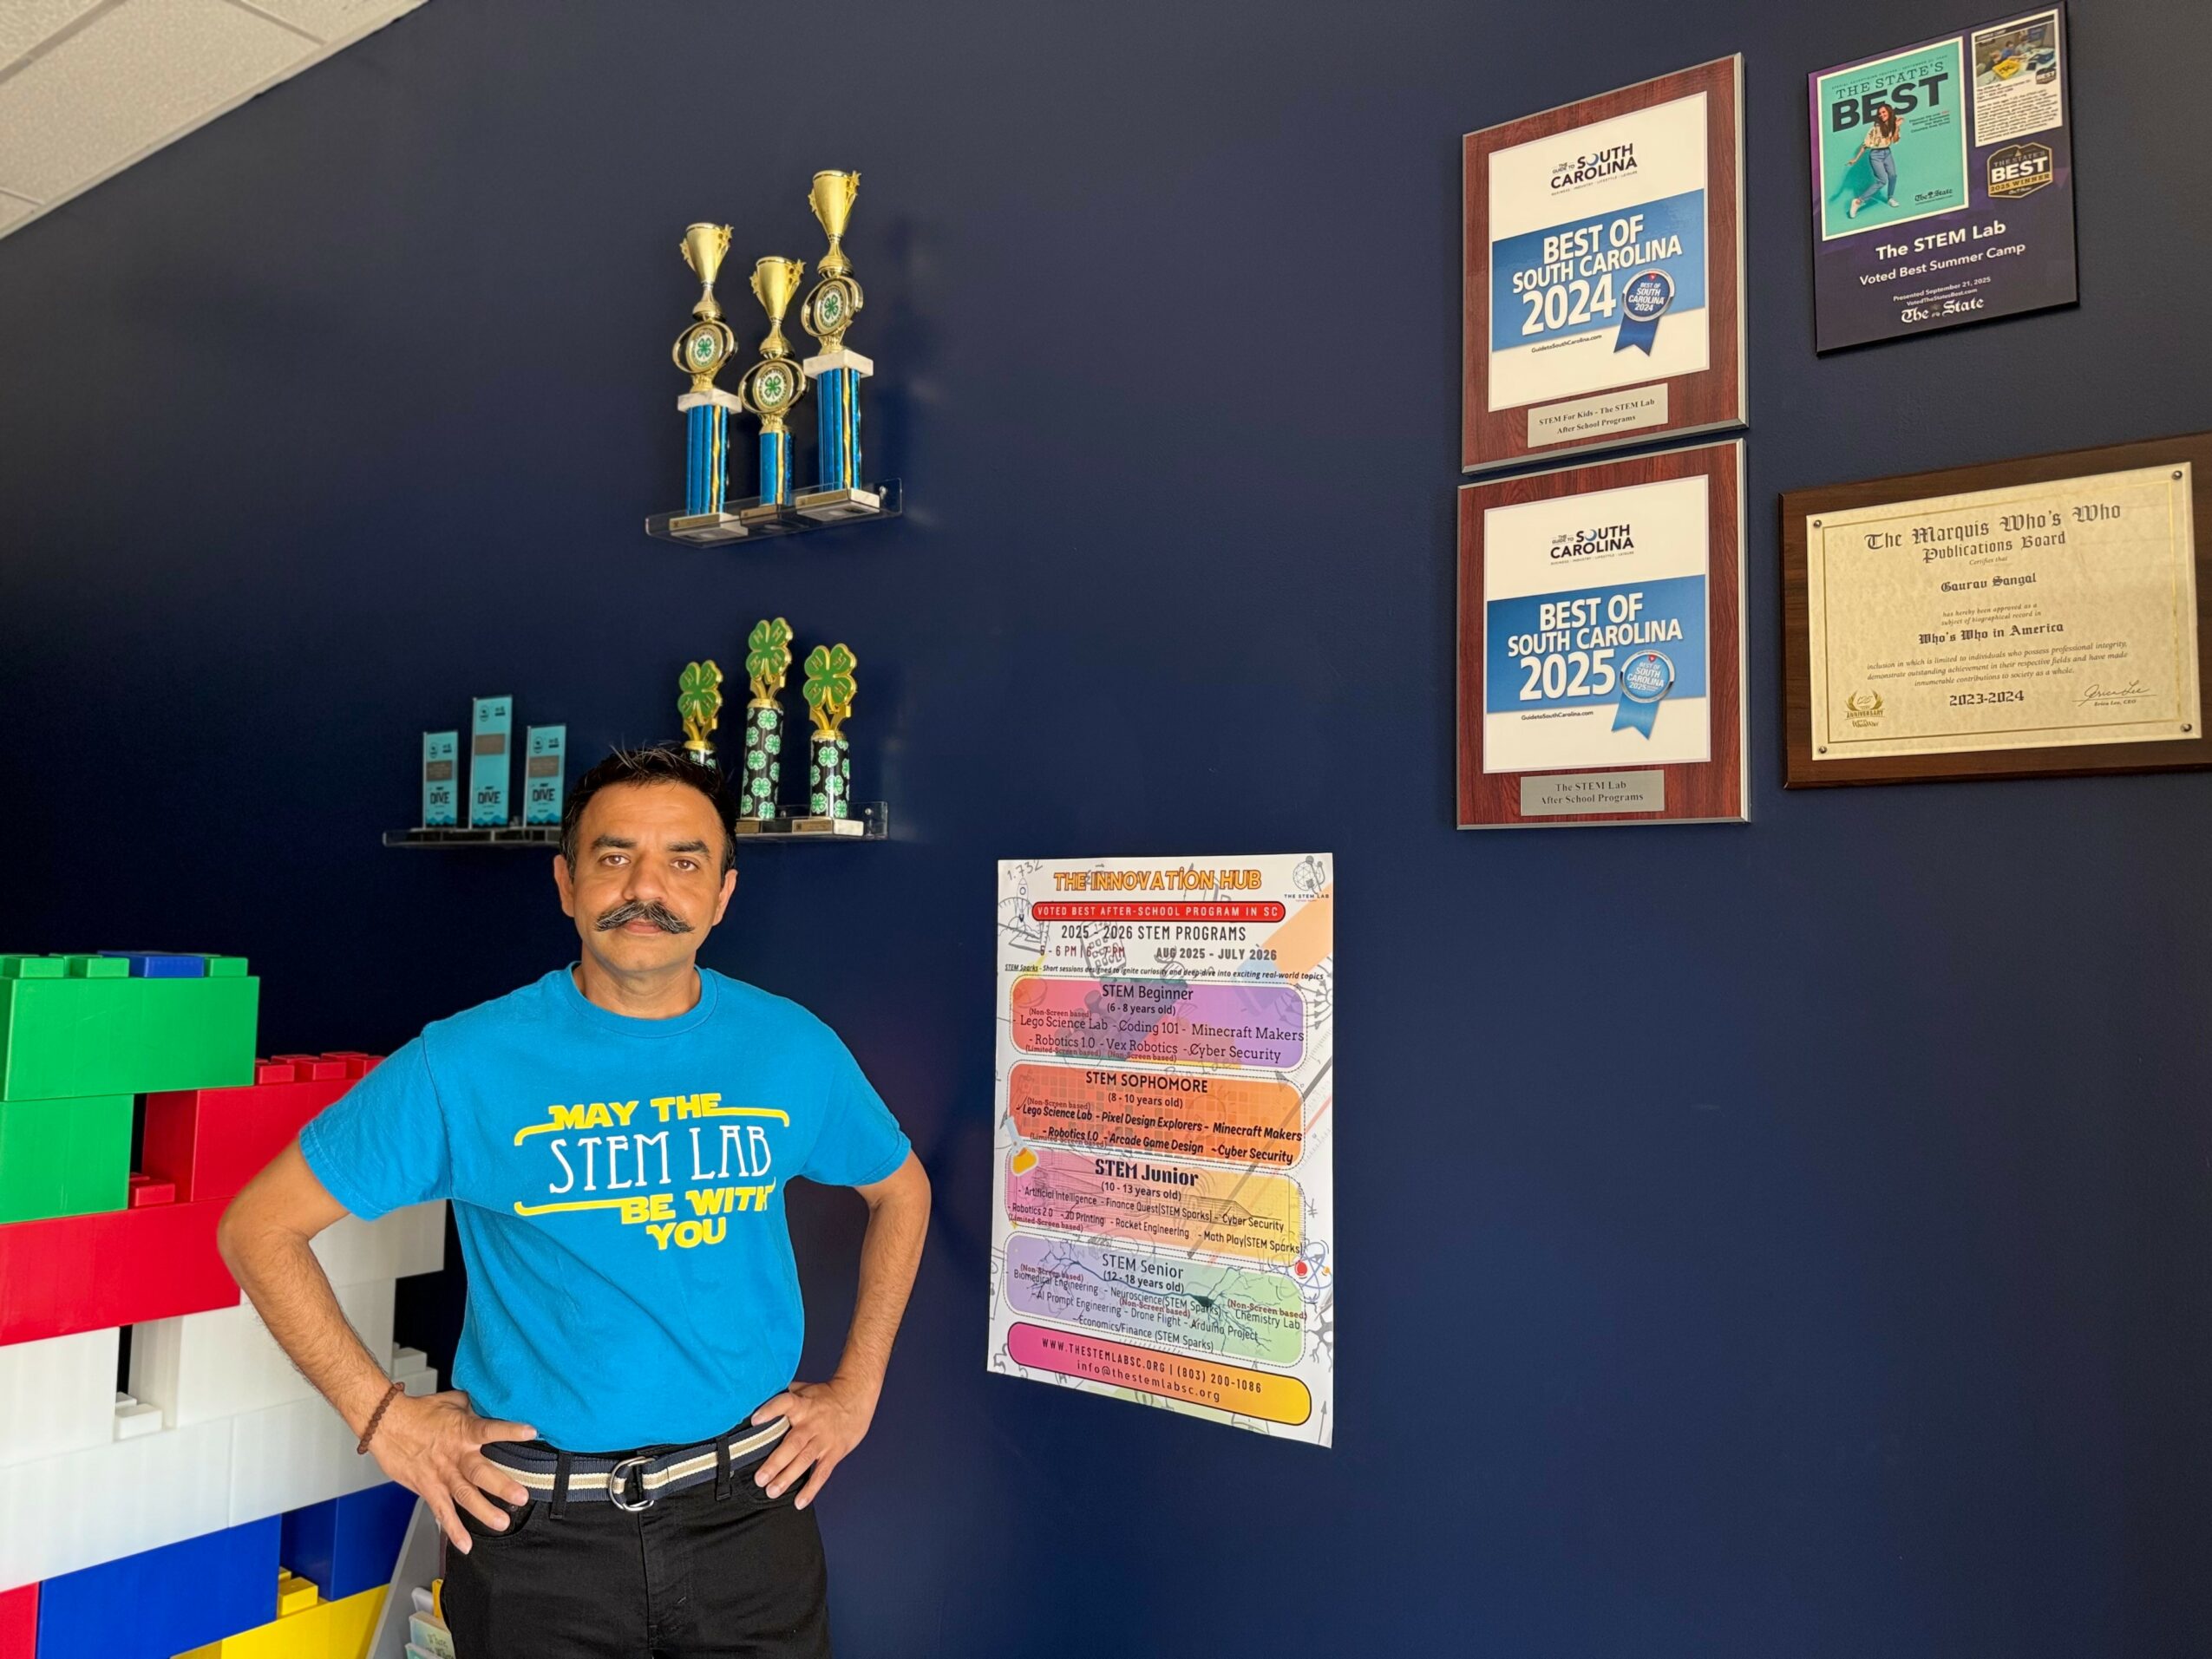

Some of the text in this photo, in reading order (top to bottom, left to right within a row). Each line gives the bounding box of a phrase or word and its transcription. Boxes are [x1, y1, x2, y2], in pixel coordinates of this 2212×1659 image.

[1836, 82, 1870, 100] THE
[1875, 62, 1944, 88] STATE'S
[1832, 72, 1948, 132] BEST
[1577, 143, 1633, 169] SOUTH
[1992, 156, 2048, 183] BEST
[1551, 156, 1638, 189] CAROLINA
[1990, 184, 2011, 193] 2025
[2012, 173, 2050, 187] WINNER
[1544, 214, 1643, 265] BEST OF
[1875, 220, 2006, 260] The STEM Lab
[1513, 234, 1683, 293] SOUTH CAROLINA
[1860, 244, 2026, 286] Voted Best Summer Camp
[1893, 291, 1924, 302] Presented
[1926, 283, 1960, 296] September
[1974, 276, 1991, 285] 2025
[1522, 273, 1616, 336] 2024
[1901, 297, 1985, 323] The State
[1531, 335, 1602, 353] GuidetoSouthCarolina.com
[1539, 416, 1561, 425] STEM
[1615, 402, 1638, 411] STEM
[1640, 399, 1655, 408] Lab
[1577, 421, 1600, 430] School
[1601, 415, 1636, 427] Programs
[1576, 524, 1630, 543] SOUTH
[1865, 503, 2121, 550] The Marquis Who's Who
[1551, 537, 1634, 558] CAROLINA
[1922, 531, 2066, 564] Publications Board
[1993, 572, 2037, 588] Sangal
[1541, 591, 1643, 631] BEST OF
[1508, 618, 1683, 657] SOUTH CAROLINA
[1919, 623, 2064, 645] Who's Who in America
[2051, 643, 2092, 655] professional
[1520, 648, 1615, 701] 2025
[1950, 690, 2025, 706] 2023-2024
[1522, 710, 1594, 721] GuidetoSouthCarolina.com
[430, 791, 449, 805] DIVE
[478, 791, 500, 805] DIVE
[533, 788, 555, 801] DIVE
[1541, 793, 1643, 805] After School Programs
[1575, 782, 1605, 791] STEM
[1608, 781, 1626, 789] Lab
[1054, 872, 1086, 892] THE
[1220, 869, 1261, 890] HUB
[1037, 907, 1278, 917] VOTED BEST AFTER-SCHOOL PROGRAM IN SC
[1062, 924, 1246, 941] 2025 2026 STEM PROGRAMS
[1155, 948, 1277, 961] AUG 2025 JULY 2026
[1103, 985, 1194, 1003] STEM Beginner
[1020, 1015, 1305, 1041] Lego Science Lab Coding 101 Minecraft Makers
[1036, 1034, 1280, 1063] Robotics Vex Robotics Cyber Security
[1086, 1072, 1207, 1093] STEM SOPHOMORE
[533, 1093, 759, 1134] MAY THE
[1023, 1105, 1302, 1141] Lego Science Lab Pixel Design Explorers Minecraft Makers
[548, 1125, 772, 1193] STEM LAB
[1049, 1127, 1293, 1166] Robotics Arcade Game Design Cyber Security
[1095, 1159, 1199, 1186] STEM Junior
[685, 1180, 775, 1216] WITH
[1025, 1186, 1284, 1233] Artificial Intelligence Finance Cyber Security
[646, 1217, 727, 1251] YOU
[1013, 1203, 1223, 1243] Robotics Printing Rocket Engineering Math
[1103, 1254, 1183, 1278] STEM Senior
[1047, 1294, 1181, 1327] Prompt Engineering Drone Flight
[1055, 1277, 1299, 1329] Engineering Chemistry Lab
[1079, 1315, 1214, 1353] Economics/Finance (STEM Sparks)
[1042, 1337, 1261, 1394] WWW.THESTEMLABSC.ORG (803) 200-1086
[1077, 1360, 1220, 1402] info@thestemlabsc.org
